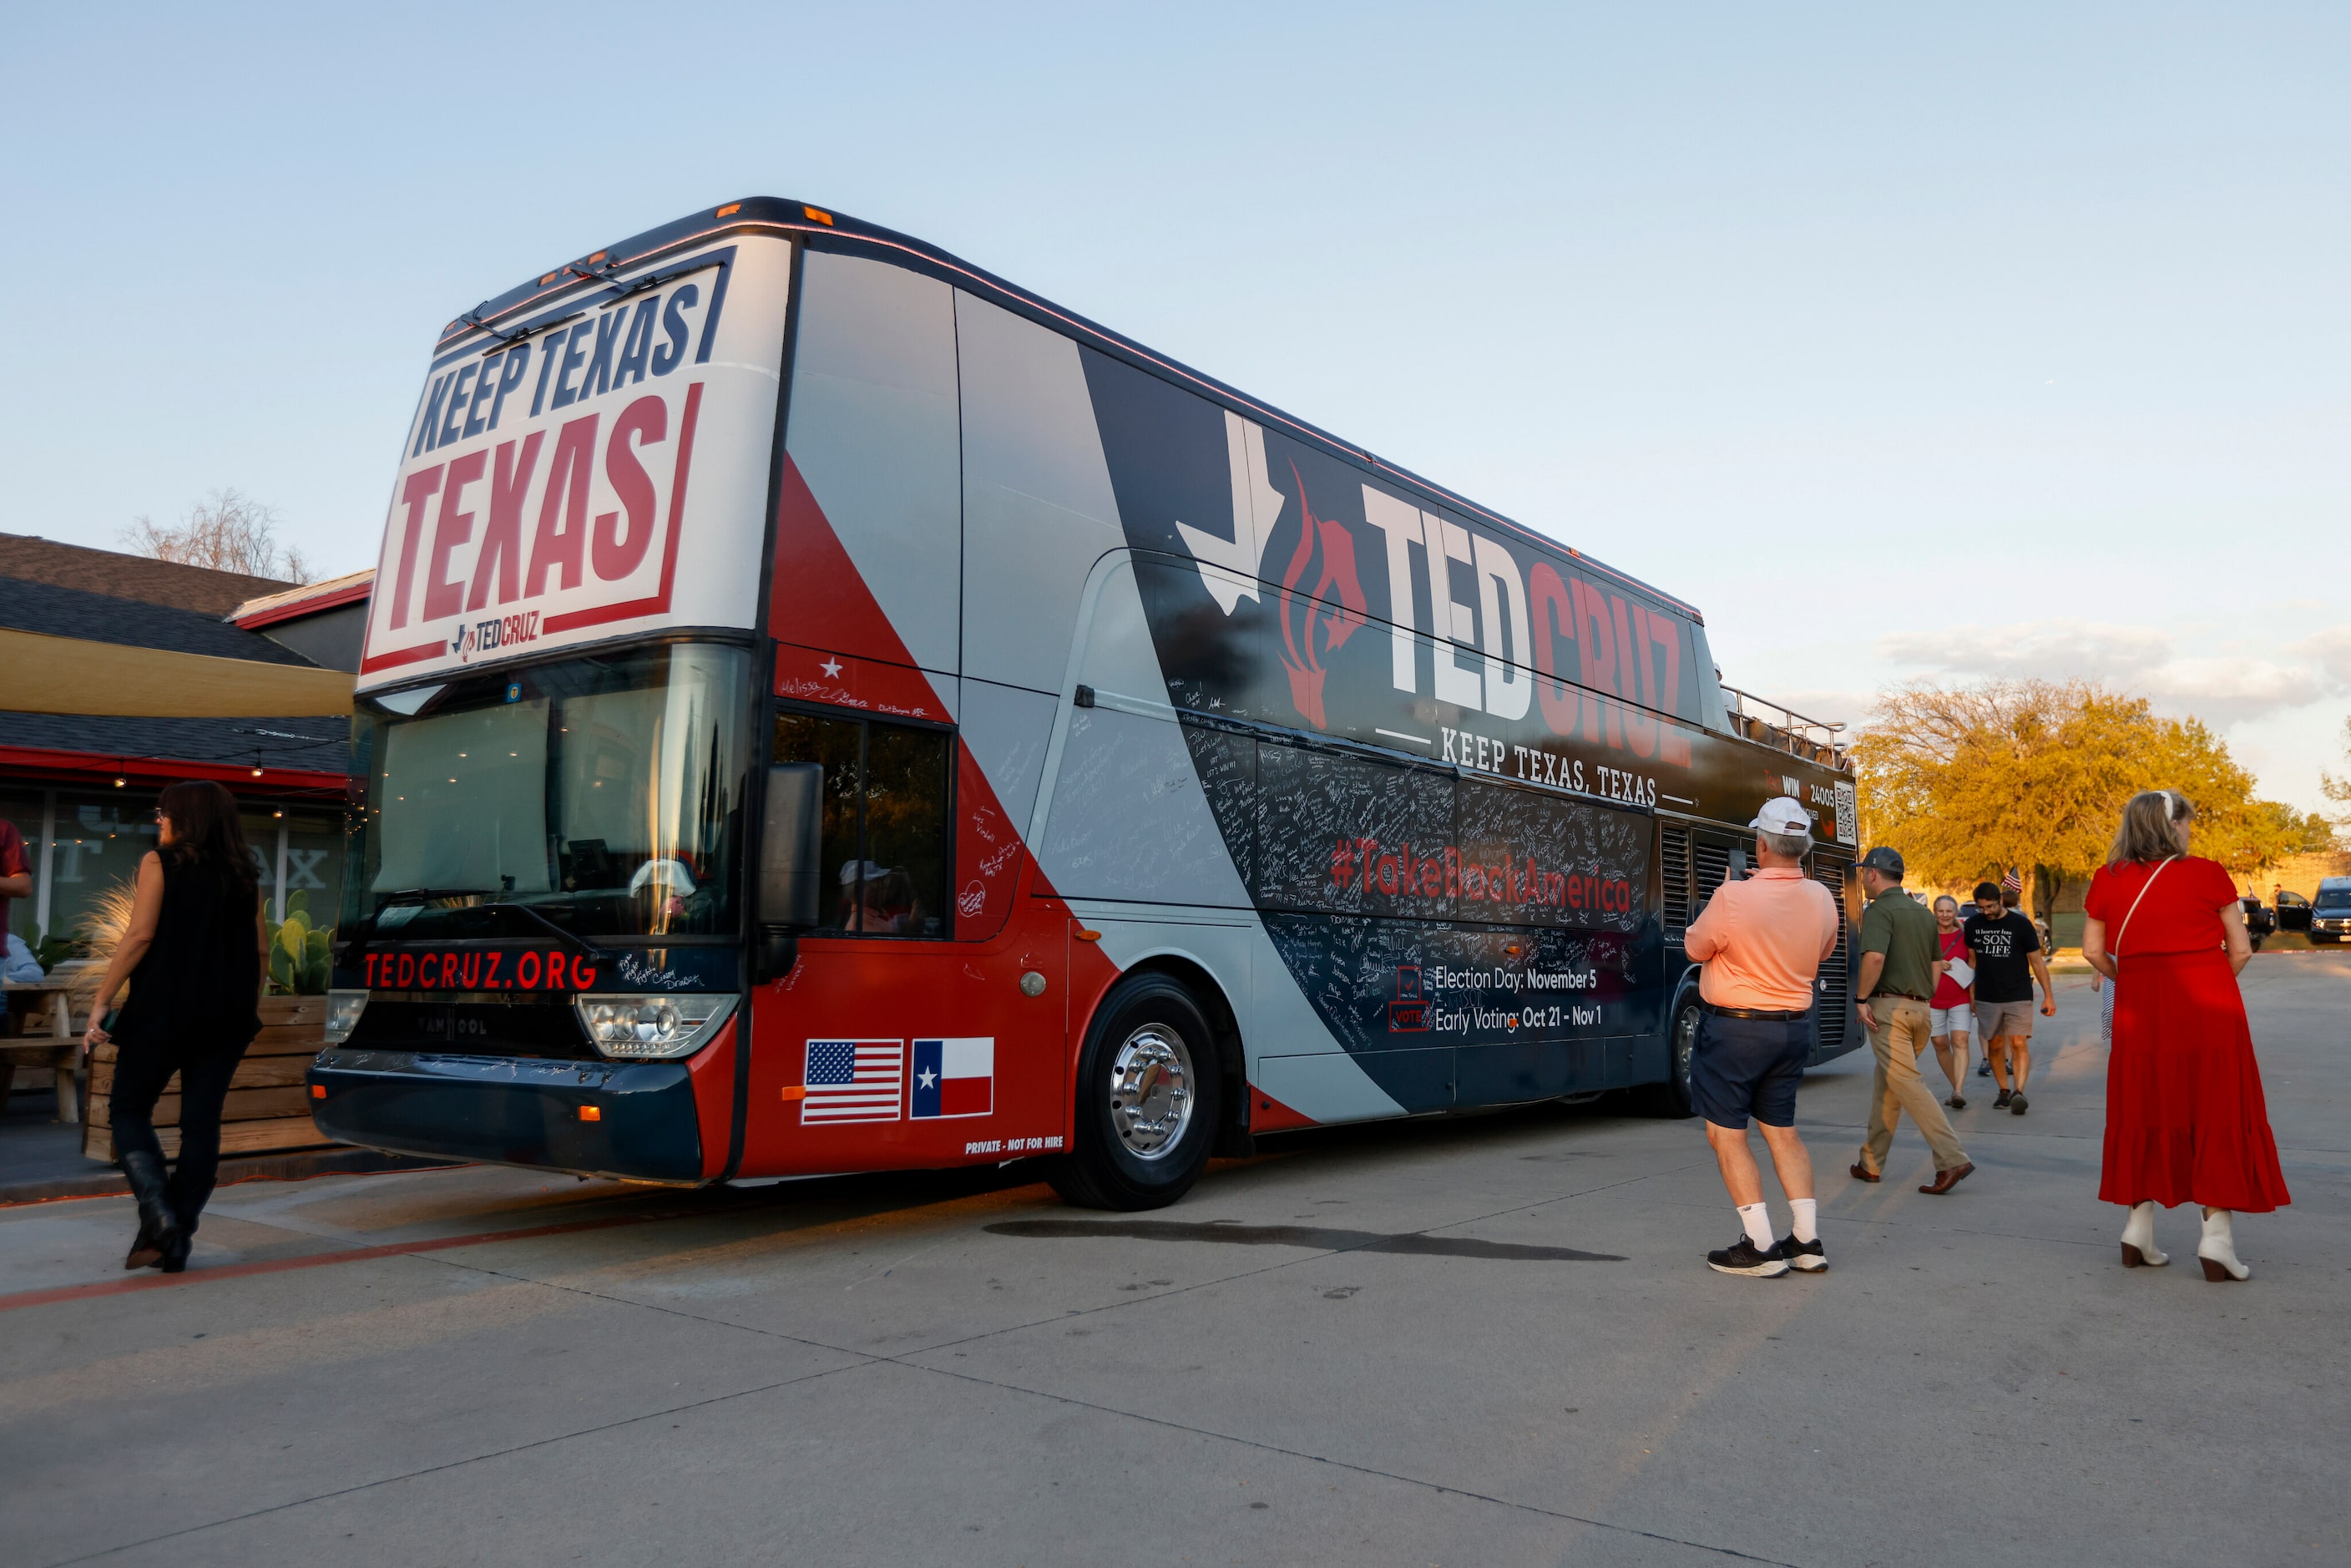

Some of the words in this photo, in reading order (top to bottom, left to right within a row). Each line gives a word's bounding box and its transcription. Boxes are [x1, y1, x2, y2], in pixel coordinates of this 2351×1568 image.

[412, 342, 531, 458] KEEP
[528, 283, 700, 418] TEXAS
[390, 394, 668, 631] TEXAS
[1441, 726, 1506, 774] KEEP
[1514, 746, 1590, 796] TEXAS,
[1596, 766, 1657, 807] TEXAS
[1782, 775, 1800, 798] WIN
[1810, 783, 1834, 807] 24005
[1330, 837, 1631, 913] #TakeBackAmerica
[1983, 934, 2012, 945] SON
[1985, 945, 2011, 954] LIFE
[365, 951, 597, 989] TEDCRUZ.ORG
[1436, 964, 1491, 989] Election
[1494, 967, 1524, 994] Day:
[1527, 968, 1588, 989] November
[1589, 969, 1597, 989] 5
[1396, 1010, 1423, 1024] VOTE
[1436, 1006, 1470, 1036] Early
[1474, 1006, 1519, 1034] Voting:
[1523, 1005, 1546, 1028] Oct
[1547, 1005, 1562, 1027] 21
[1571, 1004, 1594, 1027] Nov
[1595, 1004, 1602, 1025] 1
[965, 1141, 1001, 1155] PRIVATE
[1008, 1138, 1025, 1151] NOT
[1026, 1137, 1043, 1150] FOR
[1044, 1136, 1064, 1149] HIRE
